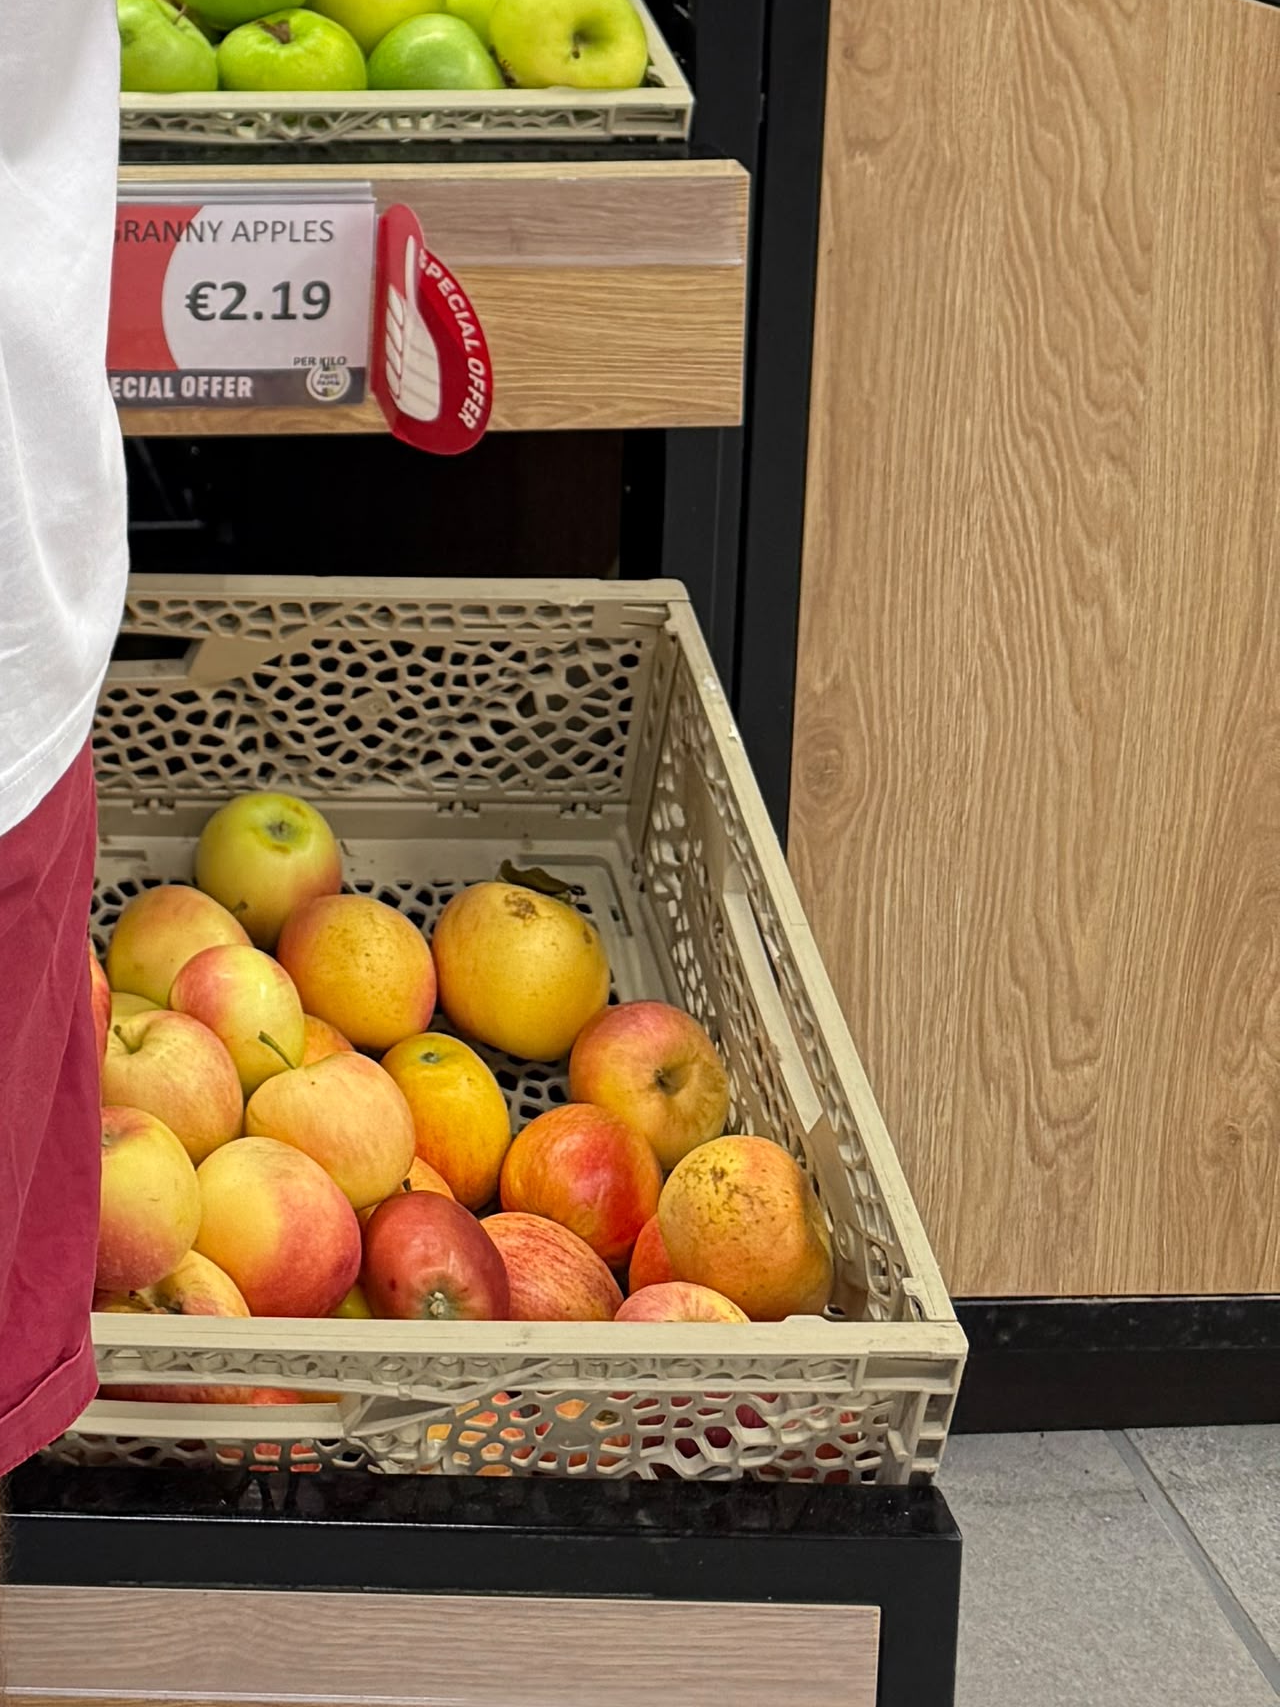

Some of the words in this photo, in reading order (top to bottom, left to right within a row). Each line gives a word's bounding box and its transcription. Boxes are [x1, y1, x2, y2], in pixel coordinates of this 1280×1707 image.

[231, 219, 335, 243] APPLES
[184, 279, 332, 321] €2.19
[293, 356, 317, 366] PER
[110, 375, 175, 399] ECIAL
[180, 375, 253, 399] OFFER
[457, 357, 487, 431] OFFER
